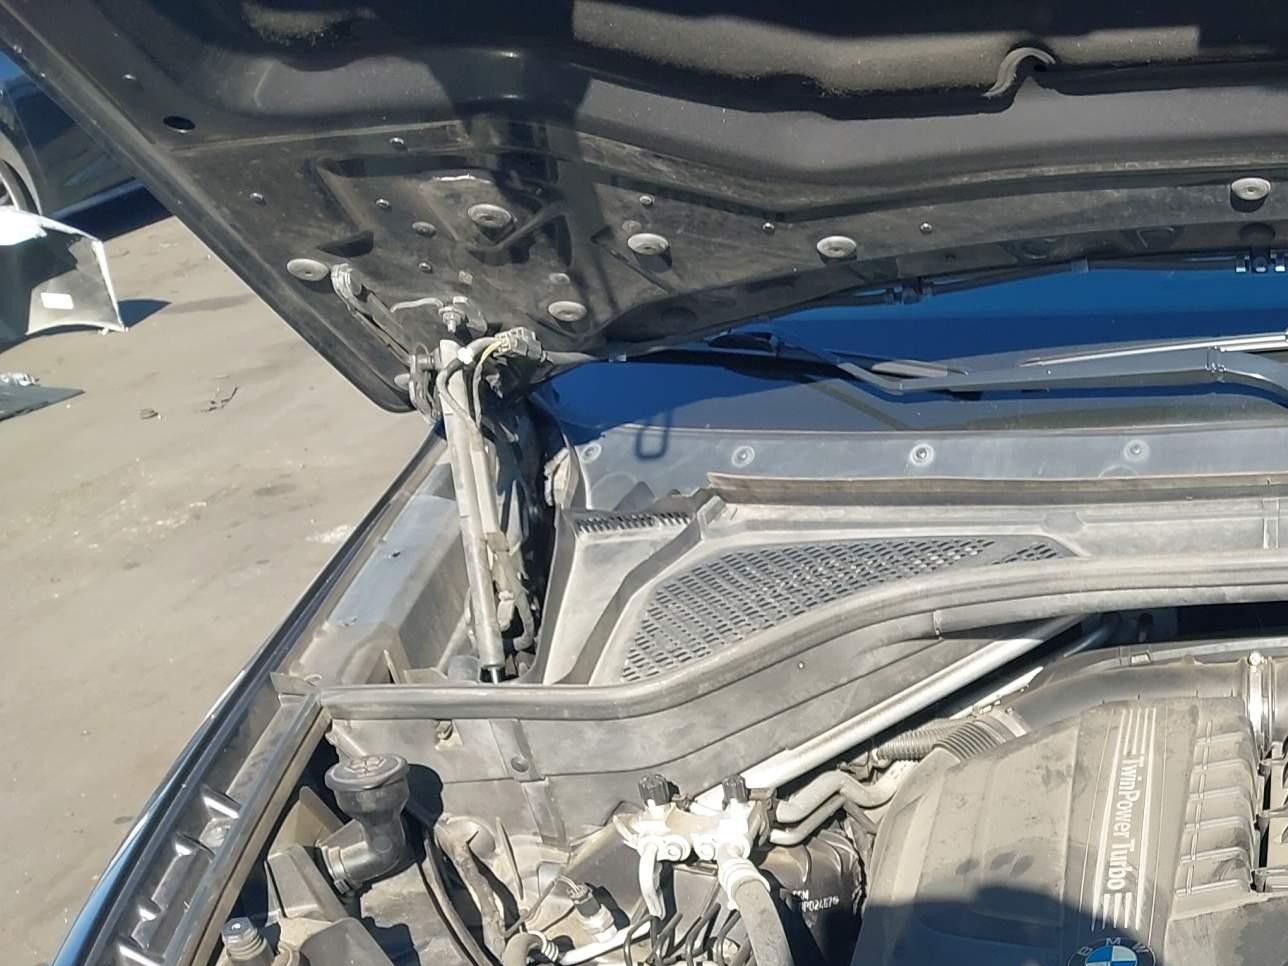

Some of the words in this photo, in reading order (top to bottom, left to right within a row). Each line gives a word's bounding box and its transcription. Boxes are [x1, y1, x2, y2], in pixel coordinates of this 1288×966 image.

[1113, 756, 1145, 838] TwinPower
[1107, 839, 1135, 890] Turbo
[1077, 937, 1149, 957] BMW
